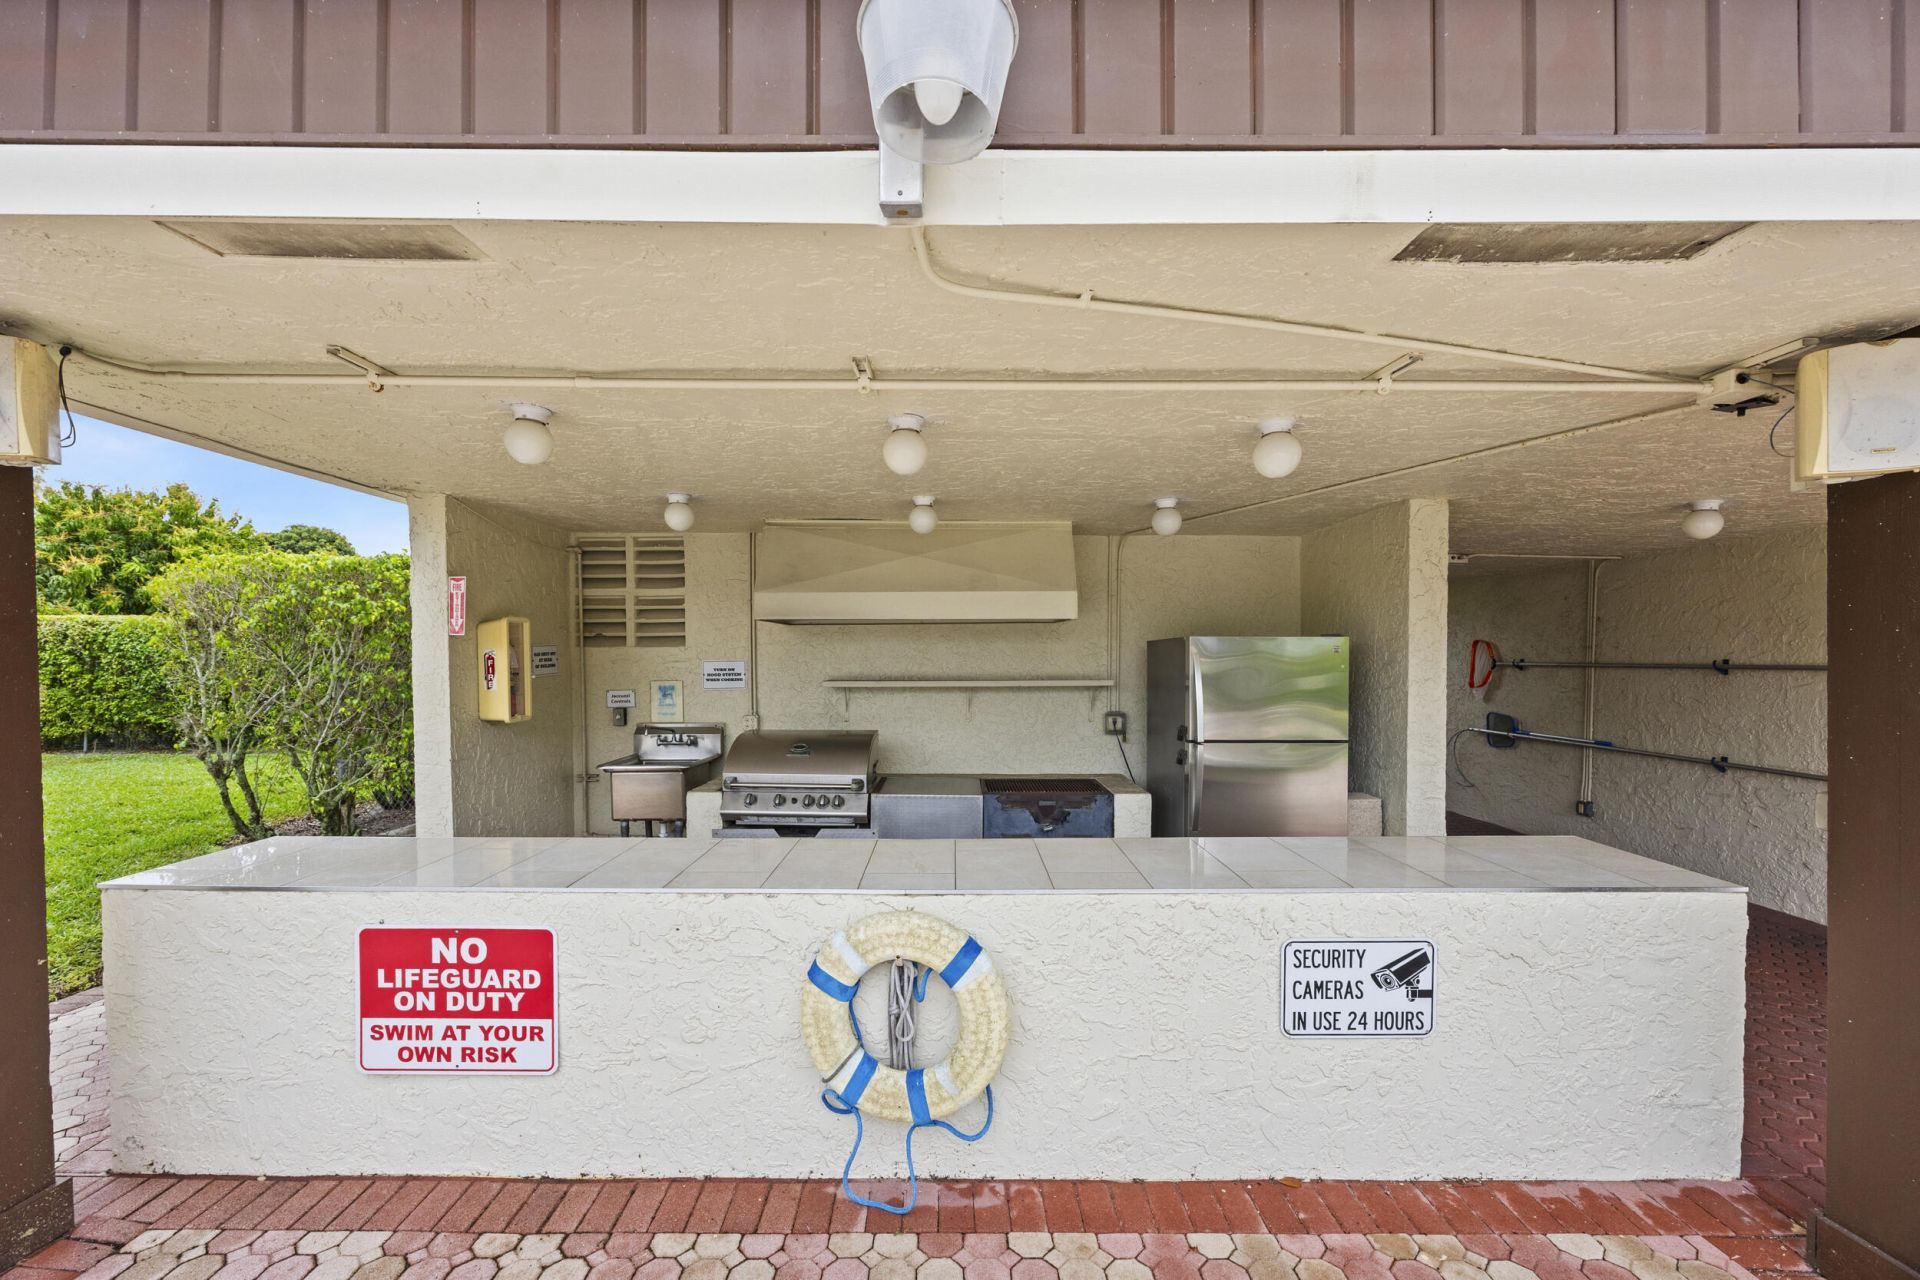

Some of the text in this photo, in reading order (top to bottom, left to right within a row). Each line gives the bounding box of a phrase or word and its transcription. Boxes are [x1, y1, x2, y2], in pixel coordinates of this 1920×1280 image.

[431, 937, 488, 964] NO
[1293, 949, 1366, 969] SECURITY
[377, 968, 542, 989] LIFEGUARD
[1292, 980, 1364, 1000] CAMERAS
[394, 991, 526, 1012] ON DUTY
[1292, 1011, 1425, 1031] IN USE 24 HOURS
[370, 1025, 545, 1042] SWIM AT YOUR
[397, 1046, 518, 1063] OWN RISK
